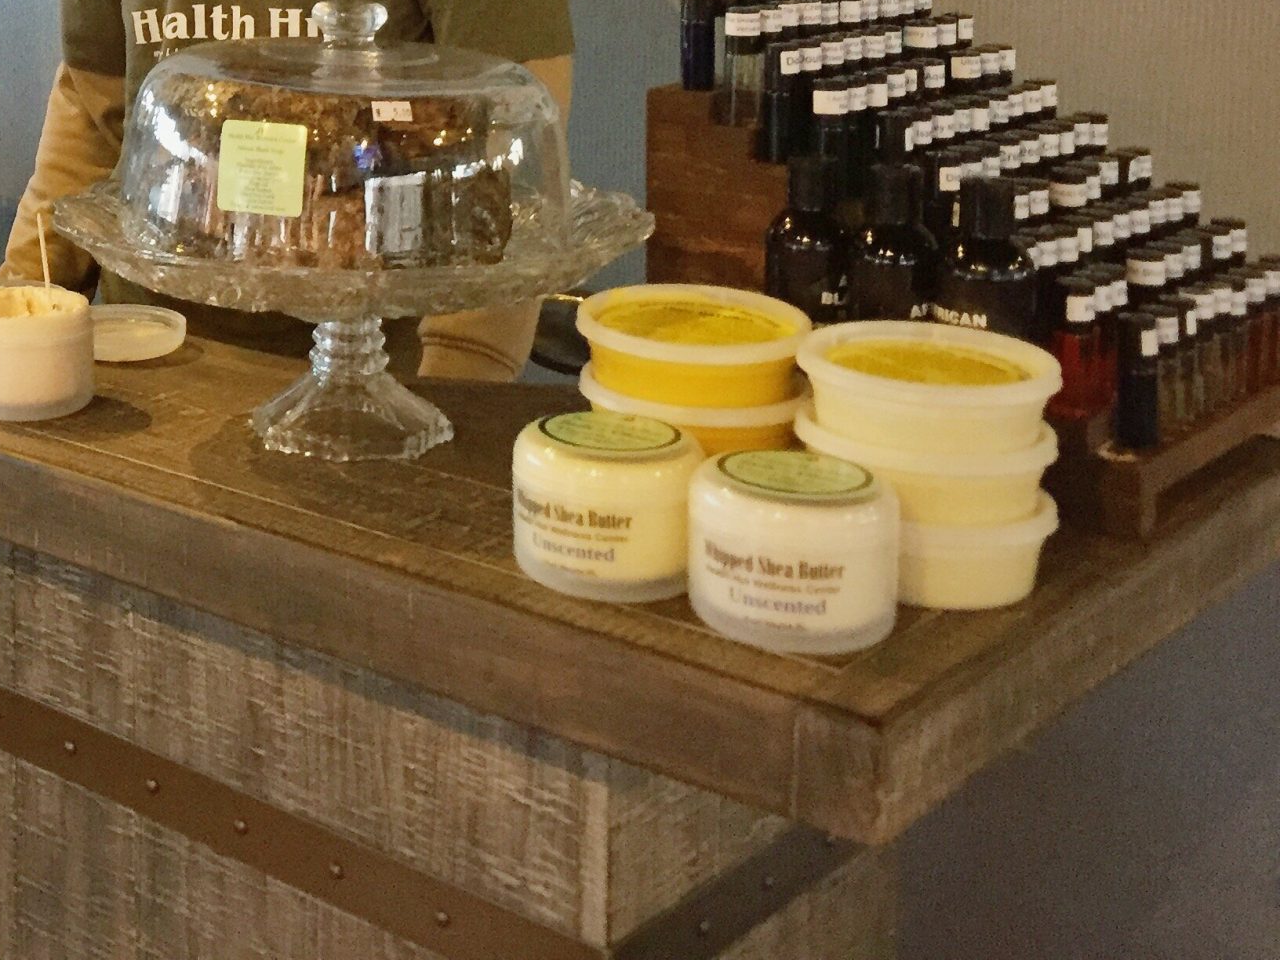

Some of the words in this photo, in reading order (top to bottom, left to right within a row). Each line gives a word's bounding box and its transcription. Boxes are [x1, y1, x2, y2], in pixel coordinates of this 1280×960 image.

[588, 510, 633, 530] Butter
[532, 531, 616, 562] Unscented
[799, 559, 846, 581] Butter
[730, 586, 827, 616] Unscented
